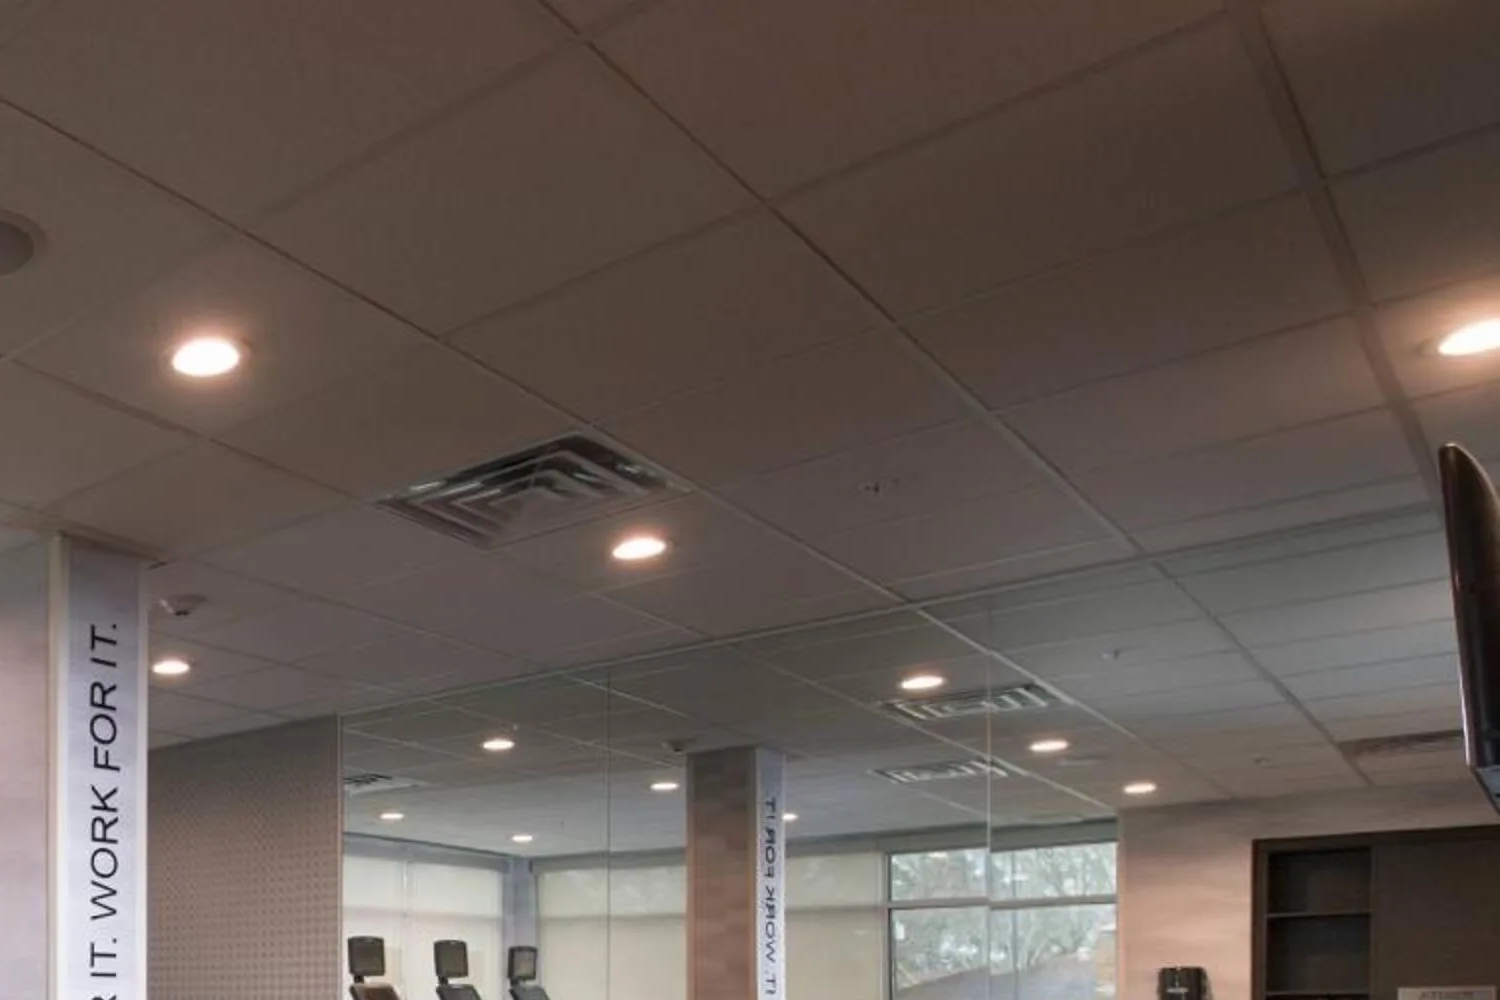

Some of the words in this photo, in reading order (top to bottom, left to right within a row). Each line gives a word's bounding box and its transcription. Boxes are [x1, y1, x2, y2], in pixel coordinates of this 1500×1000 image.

[90, 623, 118, 669] IT.
[89, 681, 121, 773] FOR
[89, 783, 120, 921] WORK
[89, 937, 119, 979] IT.
